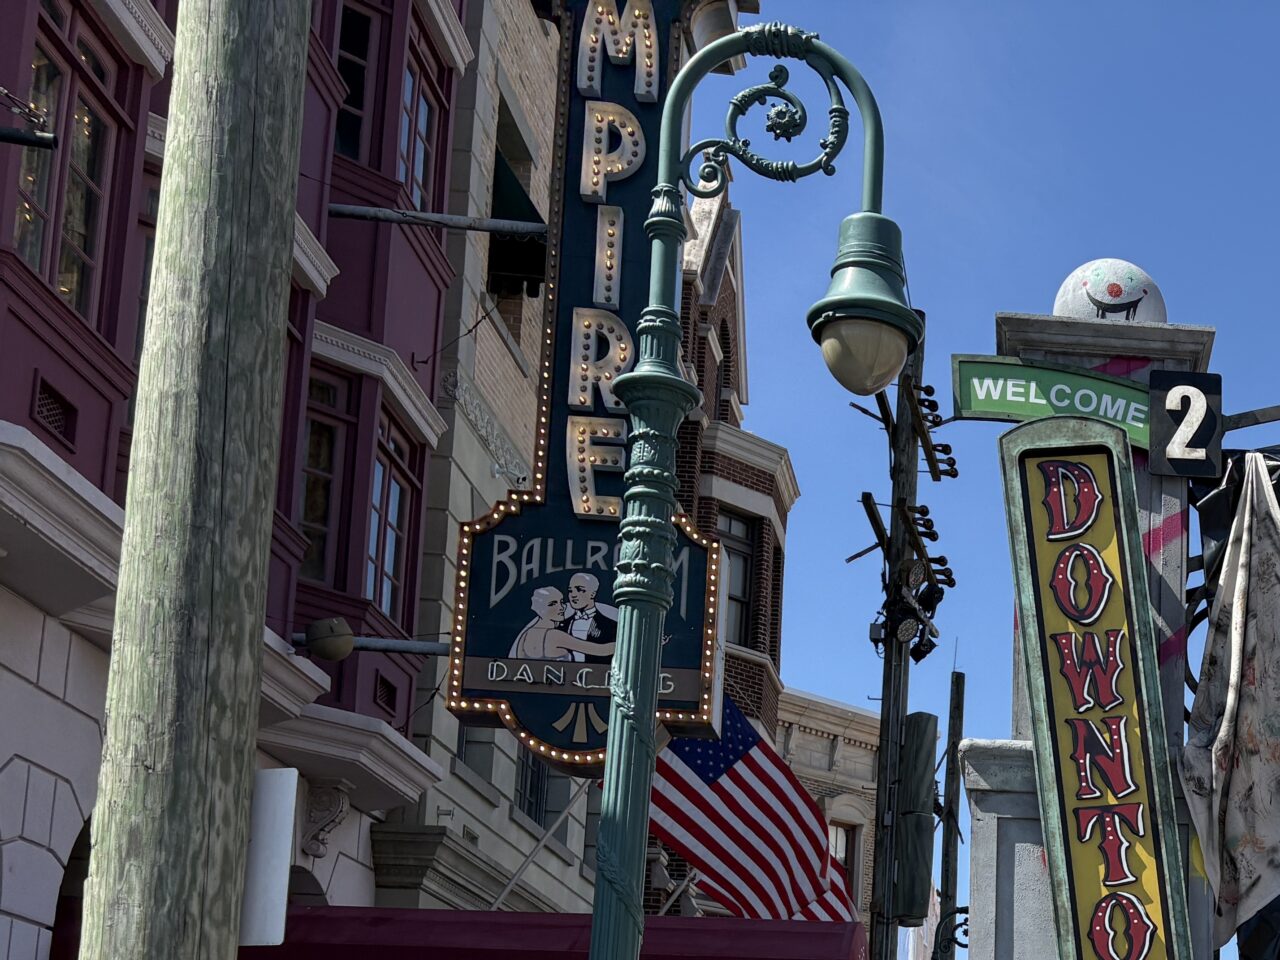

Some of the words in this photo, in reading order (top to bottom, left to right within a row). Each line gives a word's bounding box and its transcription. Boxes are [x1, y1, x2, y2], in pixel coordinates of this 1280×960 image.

[972, 376, 1149, 428] WELCOME
[1165, 384, 1207, 460] 2
[490, 534, 690, 622] BALLRM
